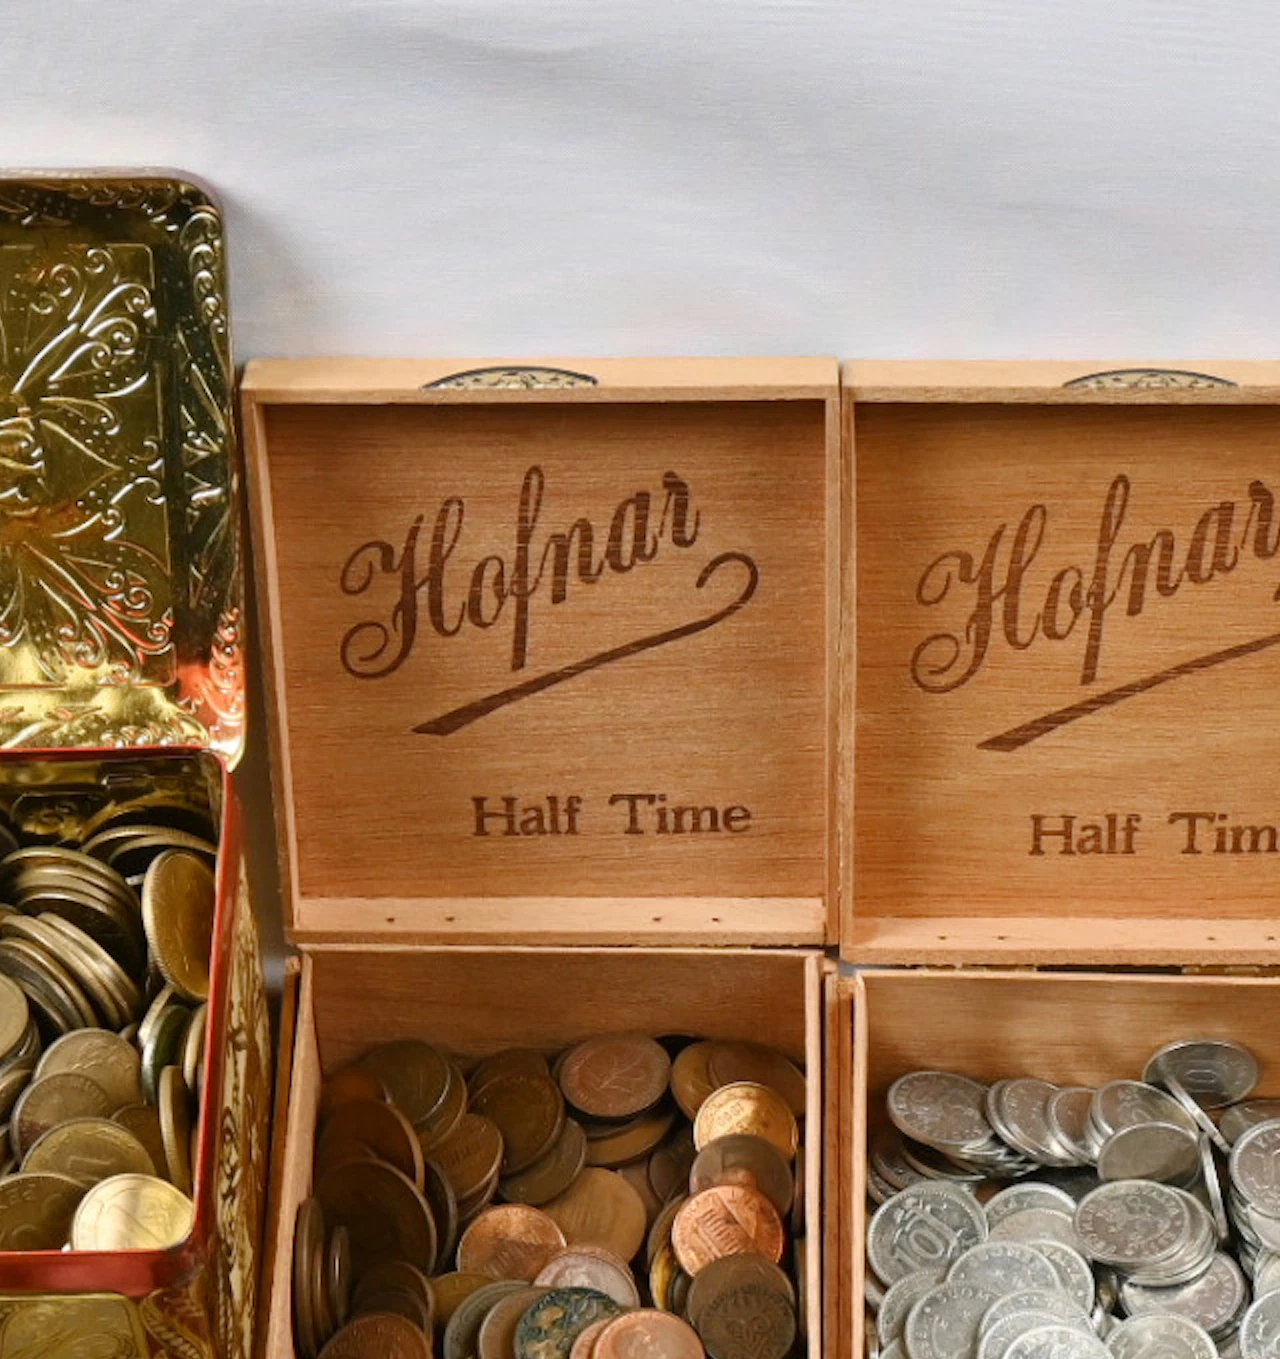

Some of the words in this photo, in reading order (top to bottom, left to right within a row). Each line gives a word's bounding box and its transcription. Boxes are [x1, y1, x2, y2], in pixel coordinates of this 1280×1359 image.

[340, 464, 701, 680] Hofnar
[470, 794, 582, 837] Half
[608, 792, 752, 836] Time
[1028, 813, 1142, 857] Half
